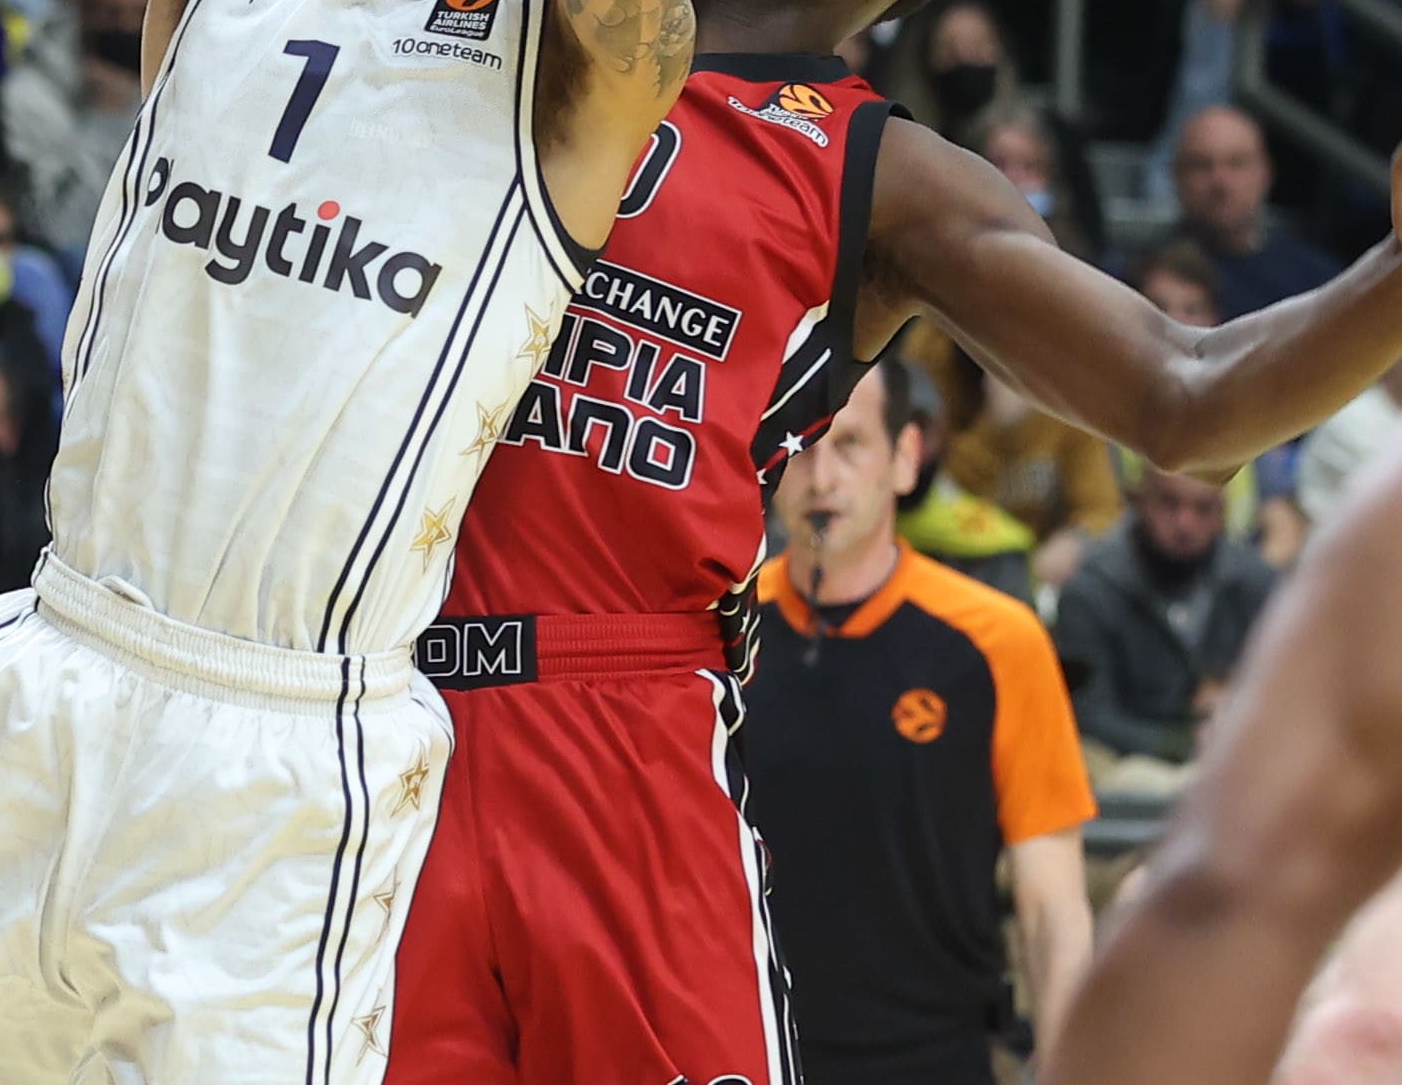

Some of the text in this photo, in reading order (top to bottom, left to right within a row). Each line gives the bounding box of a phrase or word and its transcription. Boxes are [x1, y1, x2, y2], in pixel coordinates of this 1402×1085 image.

[432, 18, 487, 31] AIRLINES
[437, 10, 490, 23] TURKISH
[268, 38, 340, 165] 1
[145, 156, 443, 319] aytika
[576, 269, 730, 347] CHANGE
